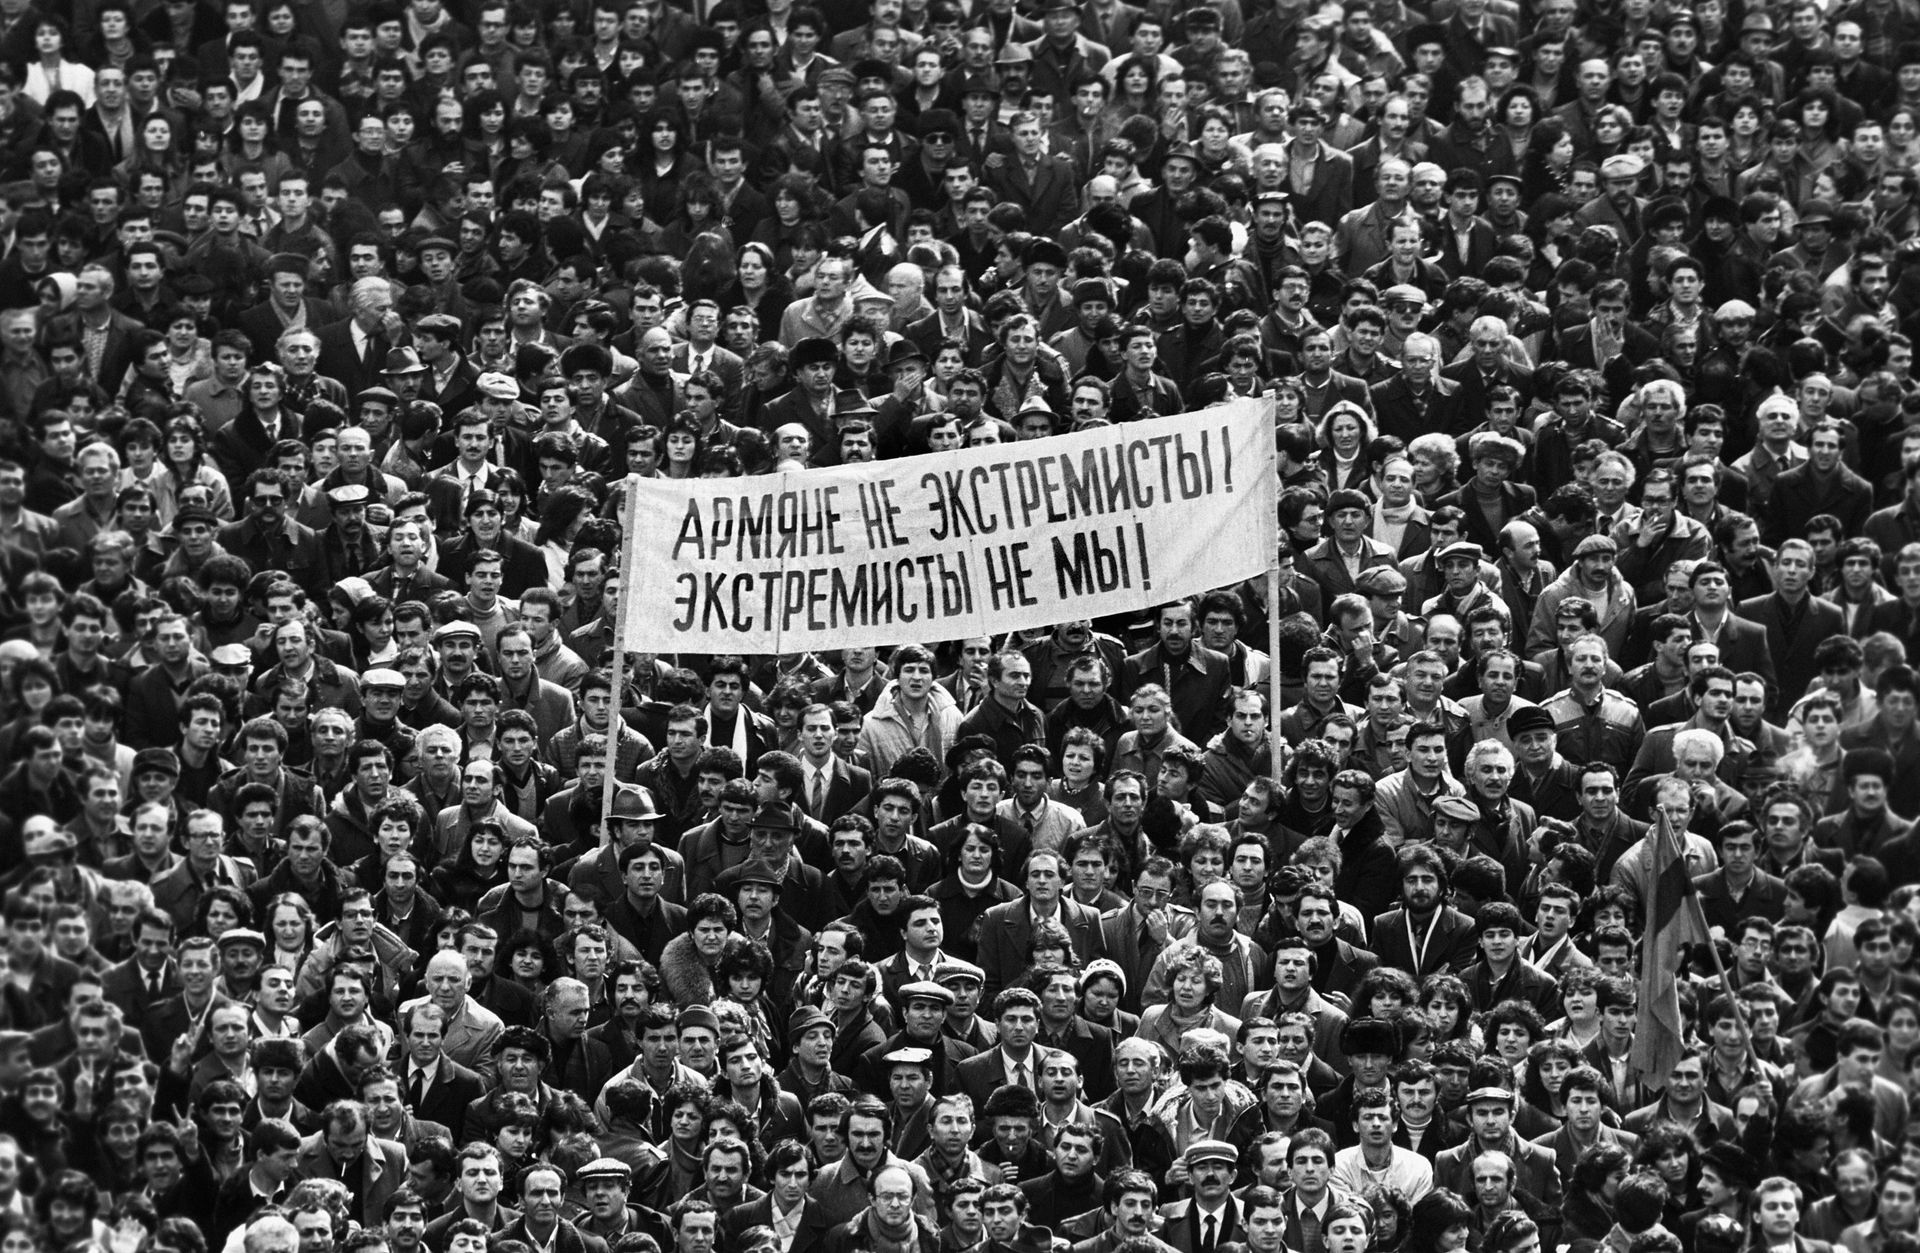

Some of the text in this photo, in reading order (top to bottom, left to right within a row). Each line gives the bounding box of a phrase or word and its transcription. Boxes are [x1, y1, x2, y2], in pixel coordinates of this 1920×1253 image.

[671, 425, 1234, 562] АРМЯНЕ НЕ ЭКСТРЕМИСТЫ!
[672, 522, 1151, 633] ЭКСТРЕМИСТЫ НЕ МЫ!
